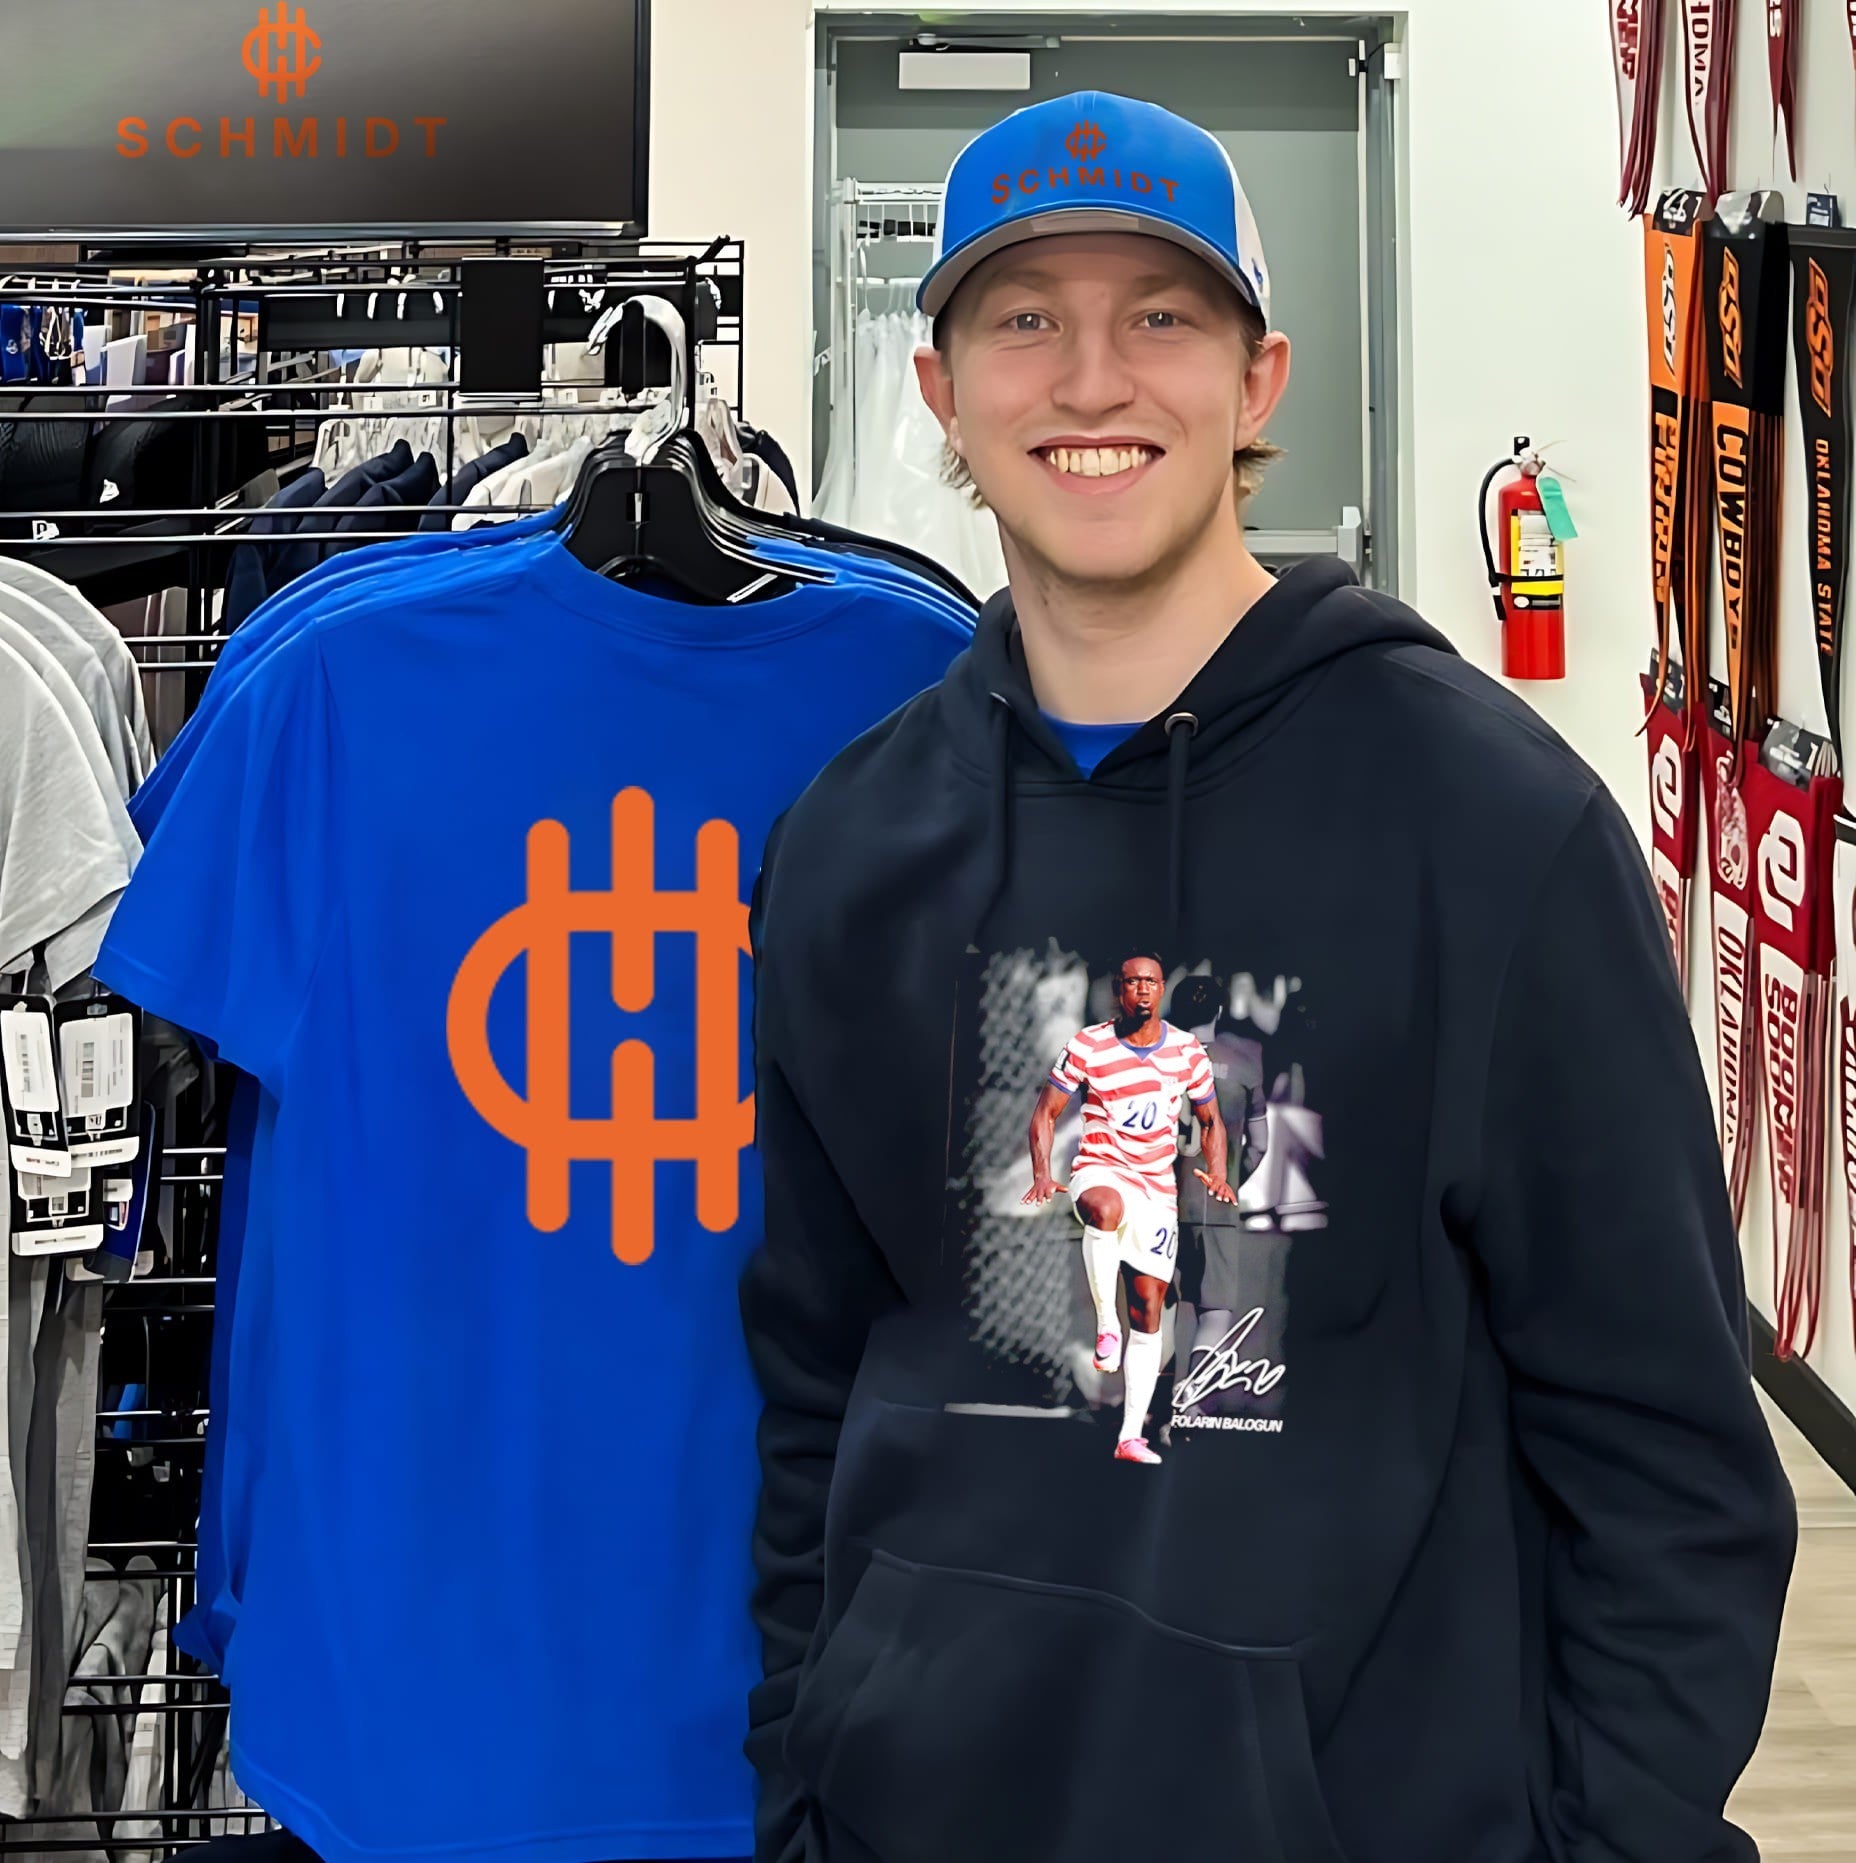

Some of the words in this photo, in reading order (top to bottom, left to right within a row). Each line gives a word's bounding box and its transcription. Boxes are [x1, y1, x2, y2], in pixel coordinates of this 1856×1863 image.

[115, 116, 447, 158] SCHMIDT
[991, 166, 1179, 204] SCHMIDT
[1717, 925, 1745, 1144] OKLAHOMA
[1122, 1100, 1157, 1130] 20
[1150, 1227, 1177, 1259] 20
[1171, 1414, 1222, 1429] FOLARIN
[1222, 1417, 1284, 1433] BALOGUN
